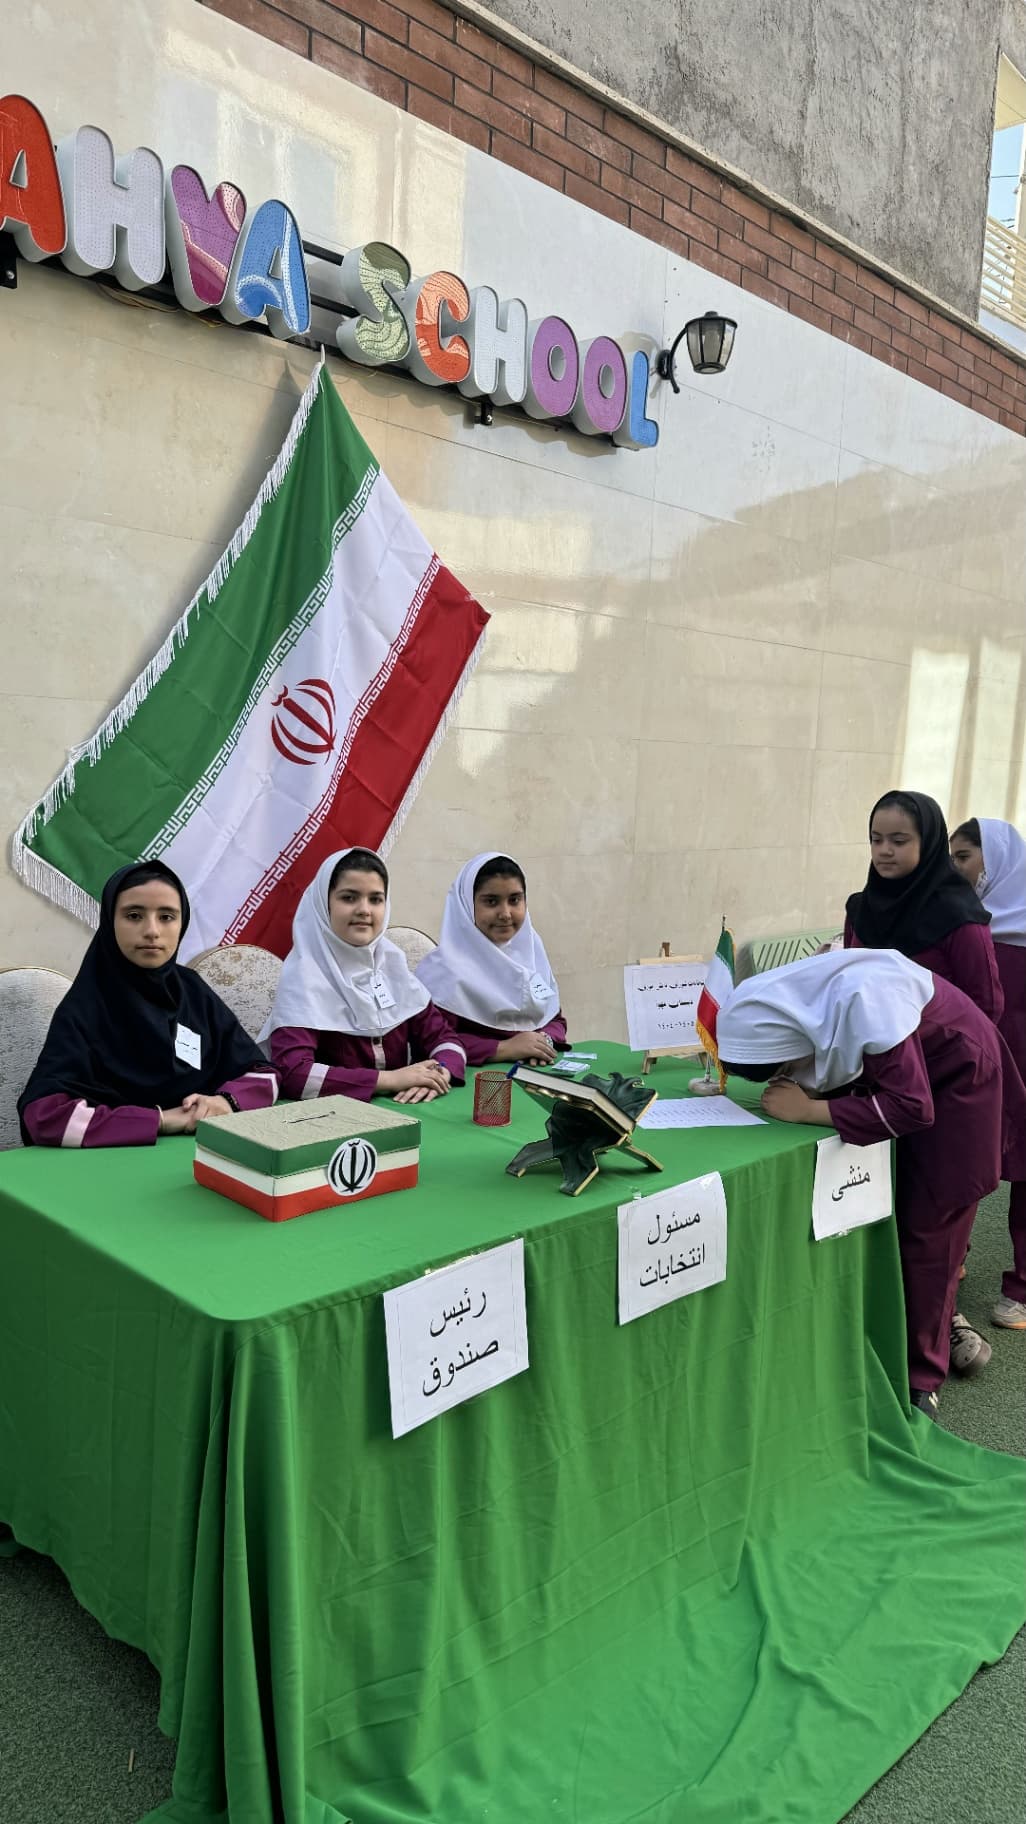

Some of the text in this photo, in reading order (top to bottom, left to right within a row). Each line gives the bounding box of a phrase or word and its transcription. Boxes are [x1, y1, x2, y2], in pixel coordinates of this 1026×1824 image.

[341, 241, 659, 449] SCHOOL
[831, 1165, 871, 1201] منشی
[647, 1211, 701, 1245] مسئول
[640, 1241, 705, 1287] انتخابات
[430, 1287, 487, 1337] رئیس
[422, 1340, 499, 1396] صندوق
